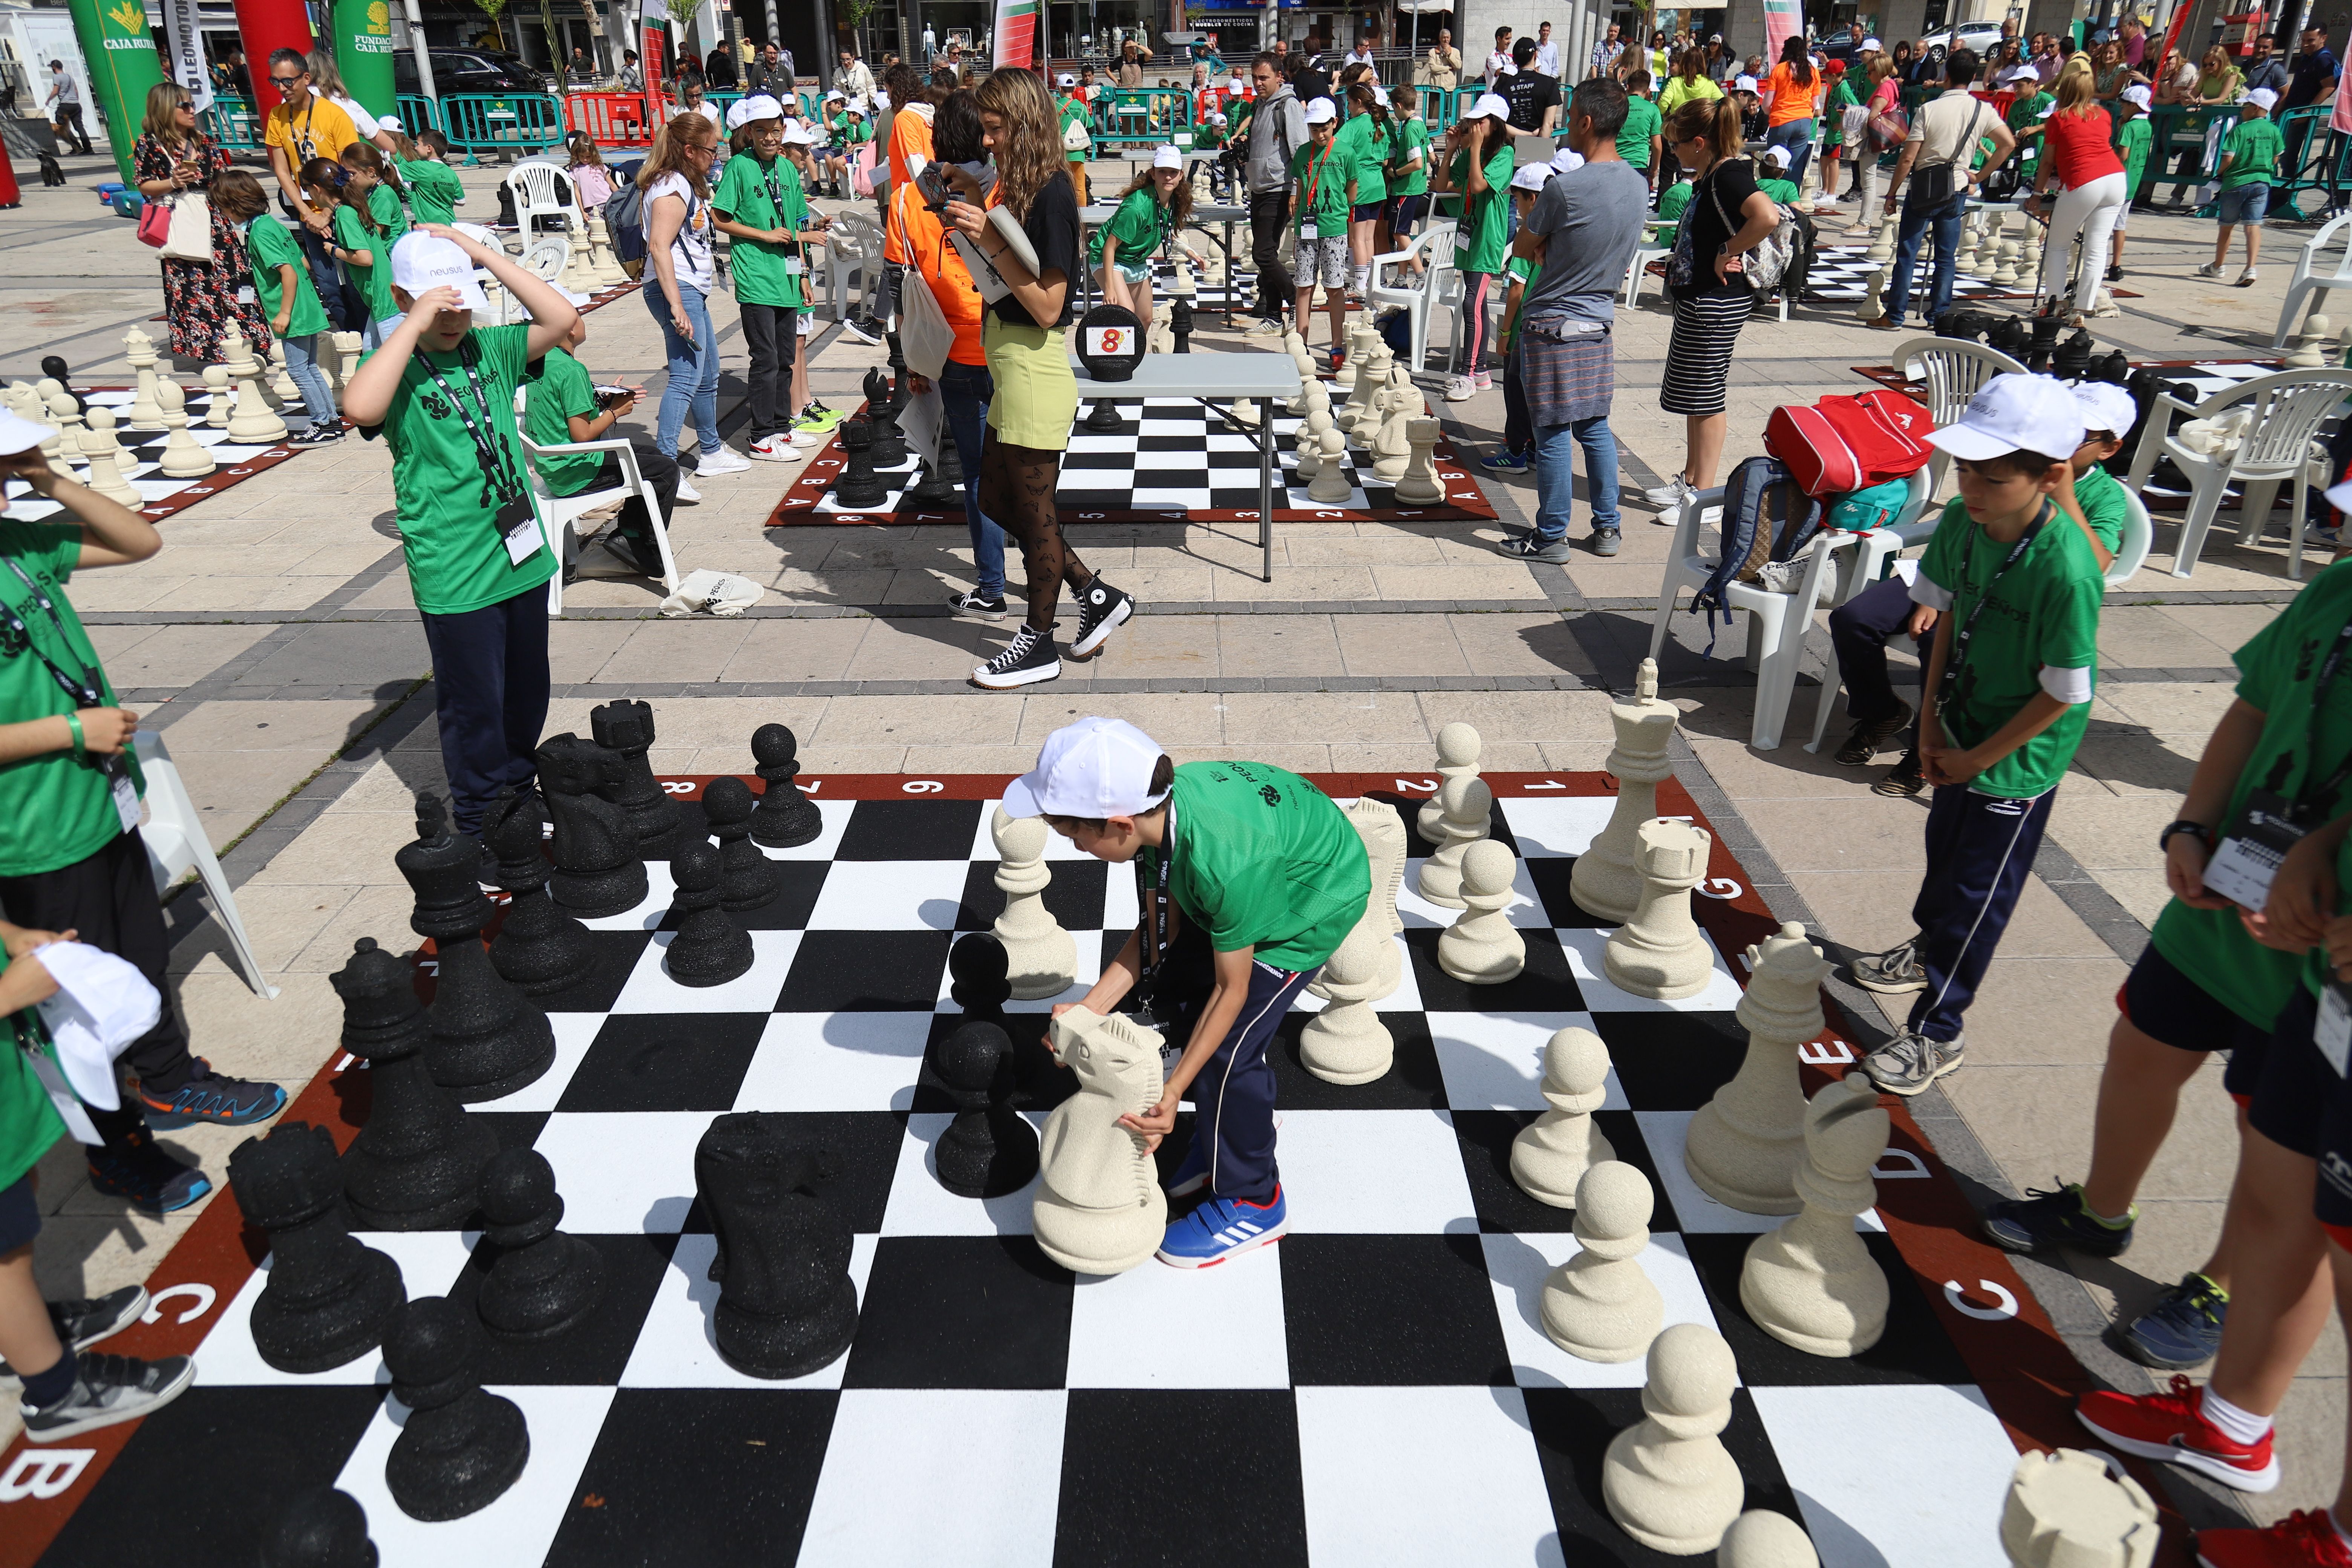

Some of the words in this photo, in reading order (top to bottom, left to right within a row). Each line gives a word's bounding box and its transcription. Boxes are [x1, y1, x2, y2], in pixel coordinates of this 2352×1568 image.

[104, 39, 133, 50] CAJA
[355, 44, 378, 53] CAJA
[430, 265, 463, 277] neusus
[1101, 329, 1120, 353] 8
[1452, 492, 1479, 500] A
[143, 506, 175, 515] A
[661, 781, 696, 794] 8
[1396, 779, 1439, 793] 2
[1524, 780, 1566, 790] 1
[1287, 784, 1299, 810] neusus
[1797, 1040, 1858, 1064] E
[1870, 1148, 1933, 1179] D
[141, 1283, 217, 1325] C
[1943, 1279, 2019, 1321] C
[0, 1448, 98, 1503] B
